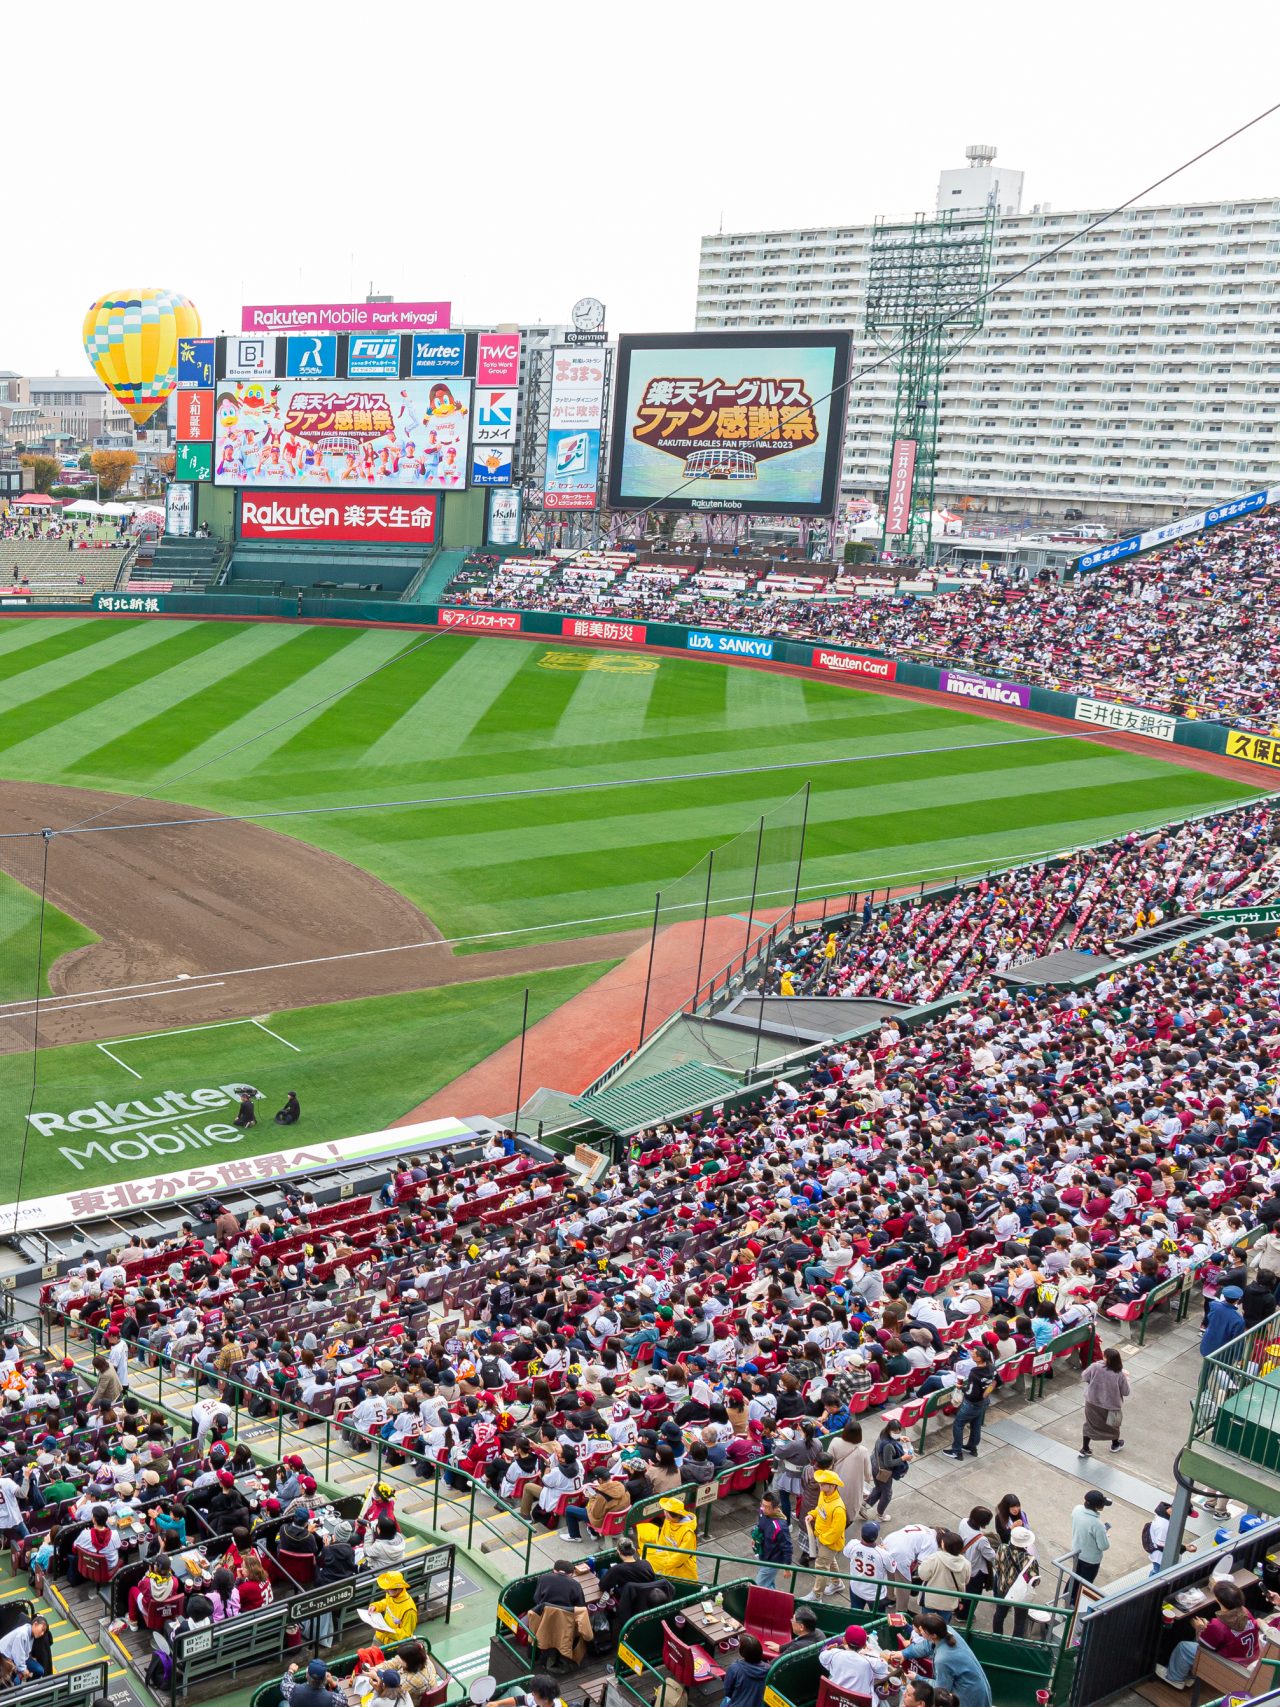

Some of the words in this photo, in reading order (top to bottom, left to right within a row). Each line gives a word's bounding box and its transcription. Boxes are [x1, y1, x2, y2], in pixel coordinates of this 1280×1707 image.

[253, 310, 317, 328] Rakuten
[320, 309, 367, 324] Mobile
[373, 311, 398, 323] Park
[401, 311, 437, 324] Miyagi
[352, 339, 397, 358] Fuji
[417, 343, 460, 358] Yurtec
[480, 344, 518, 360] TWG
[180, 342, 212, 384] 萩の月
[556, 359, 602, 382] まるまつ
[290, 393, 388, 410] 楽天イーグルス
[646, 380, 808, 406] 楽天イーグルス
[190, 393, 200, 438] 大和証券
[286, 411, 394, 431] ファン感謝祭
[553, 406, 600, 418] かに政宗
[478, 428, 511, 439] カメイ
[636, 406, 816, 441] ファン感謝祭
[658, 439, 691, 447] RAKUTEN
[722, 440, 737, 448] FAN
[738, 440, 772, 448] FESTIVAL
[772, 441, 793, 449] 2023
[178, 445, 209, 479] 清月記
[891, 443, 911, 531] 三井のリハウス
[169, 502, 190, 511] Asahi
[493, 509, 517, 519] Asahi
[691, 499, 722, 508] Rakuten
[723, 500, 742, 509] kobo
[1219, 494, 1265, 518] 東北ボール
[242, 502, 339, 531] Rakuten
[344, 505, 433, 529] 楽天生命
[1092, 541, 1138, 564] 東北ボール
[98, 598, 160, 613] 河北新報
[455, 612, 516, 628] アイリスオーヤマ
[574, 620, 633, 641] 能美防災
[689, 633, 713, 649] 山九
[719, 636, 772, 656] SANKYU
[820, 653, 860, 671] Rakuten
[862, 660, 888, 676] Card
[1079, 702, 1174, 738] 三井住友銀行
[26, 1082, 267, 1137] Rakuten
[58, 1122, 245, 1170] Mobile
[67, 1144, 346, 1217] 東北から世界へ!
[375, 1410, 383, 1422] 5
[855, 1558, 875, 1577] 33
[1241, 1633, 1255, 1658] 7
